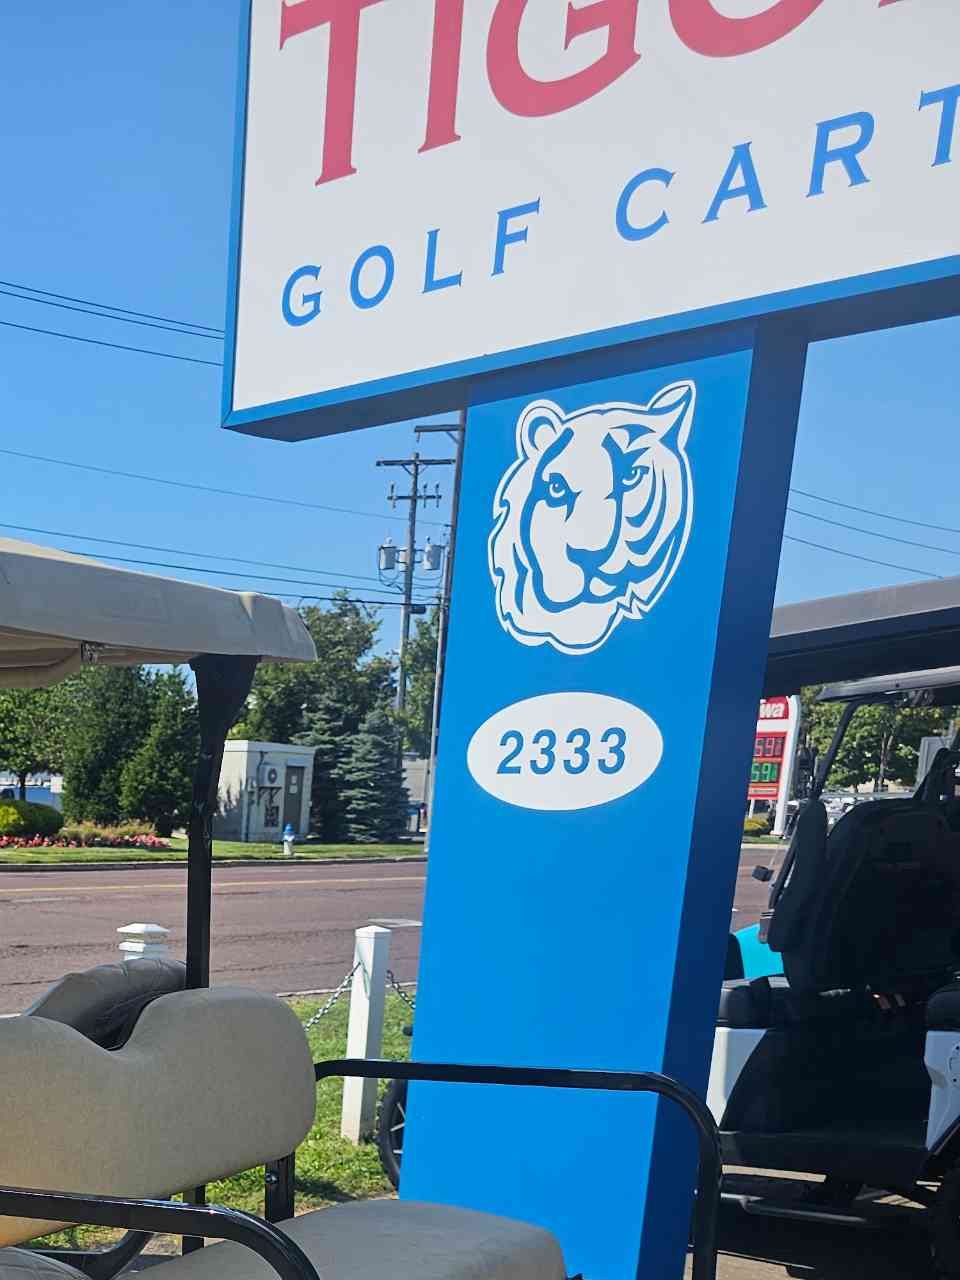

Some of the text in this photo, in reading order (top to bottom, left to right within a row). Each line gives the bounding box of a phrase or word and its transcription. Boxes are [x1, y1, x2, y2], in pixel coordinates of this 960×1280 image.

[280, 0, 902, 186] TIG
[281, 200, 540, 328] GOLF
[497, 727, 626, 774] 2333
